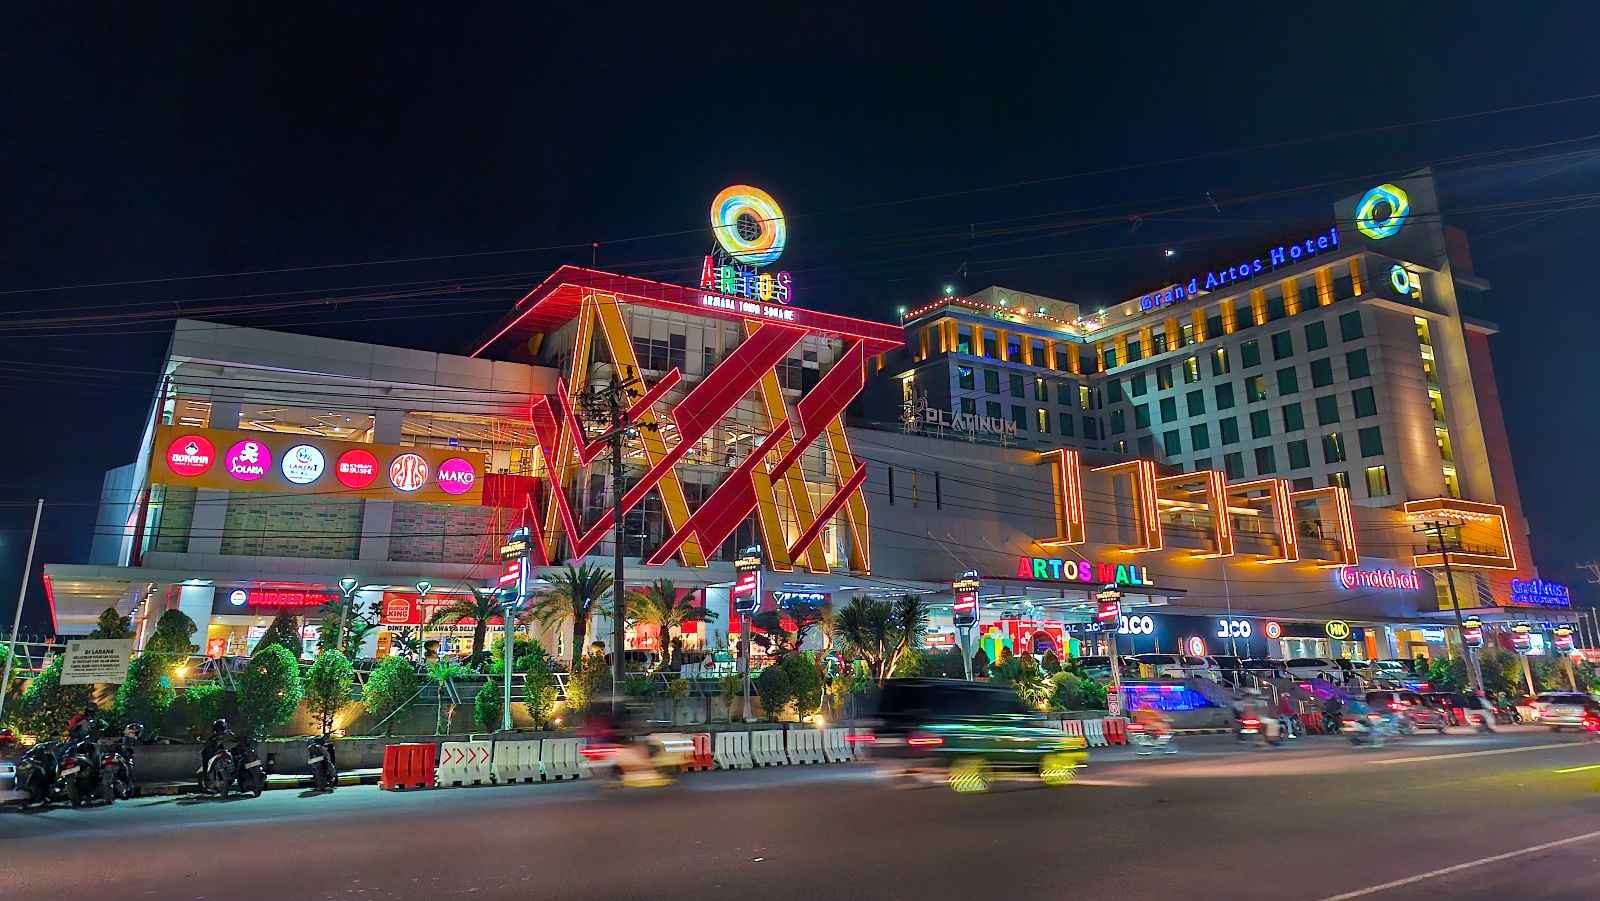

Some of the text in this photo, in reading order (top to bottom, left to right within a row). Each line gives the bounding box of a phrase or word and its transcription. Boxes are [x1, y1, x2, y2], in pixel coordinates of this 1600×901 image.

[700, 255, 793, 305] ARTOS
[1140, 227, 1338, 311] Grand Artos Hotel
[702, 294, 736, 311] ARMADA
[763, 305, 795, 321] SQUARE
[926, 407, 1018, 437] PLATINUM
[437, 470, 475, 484] MAKO
[1017, 556, 1155, 586] ARTOS MALL
